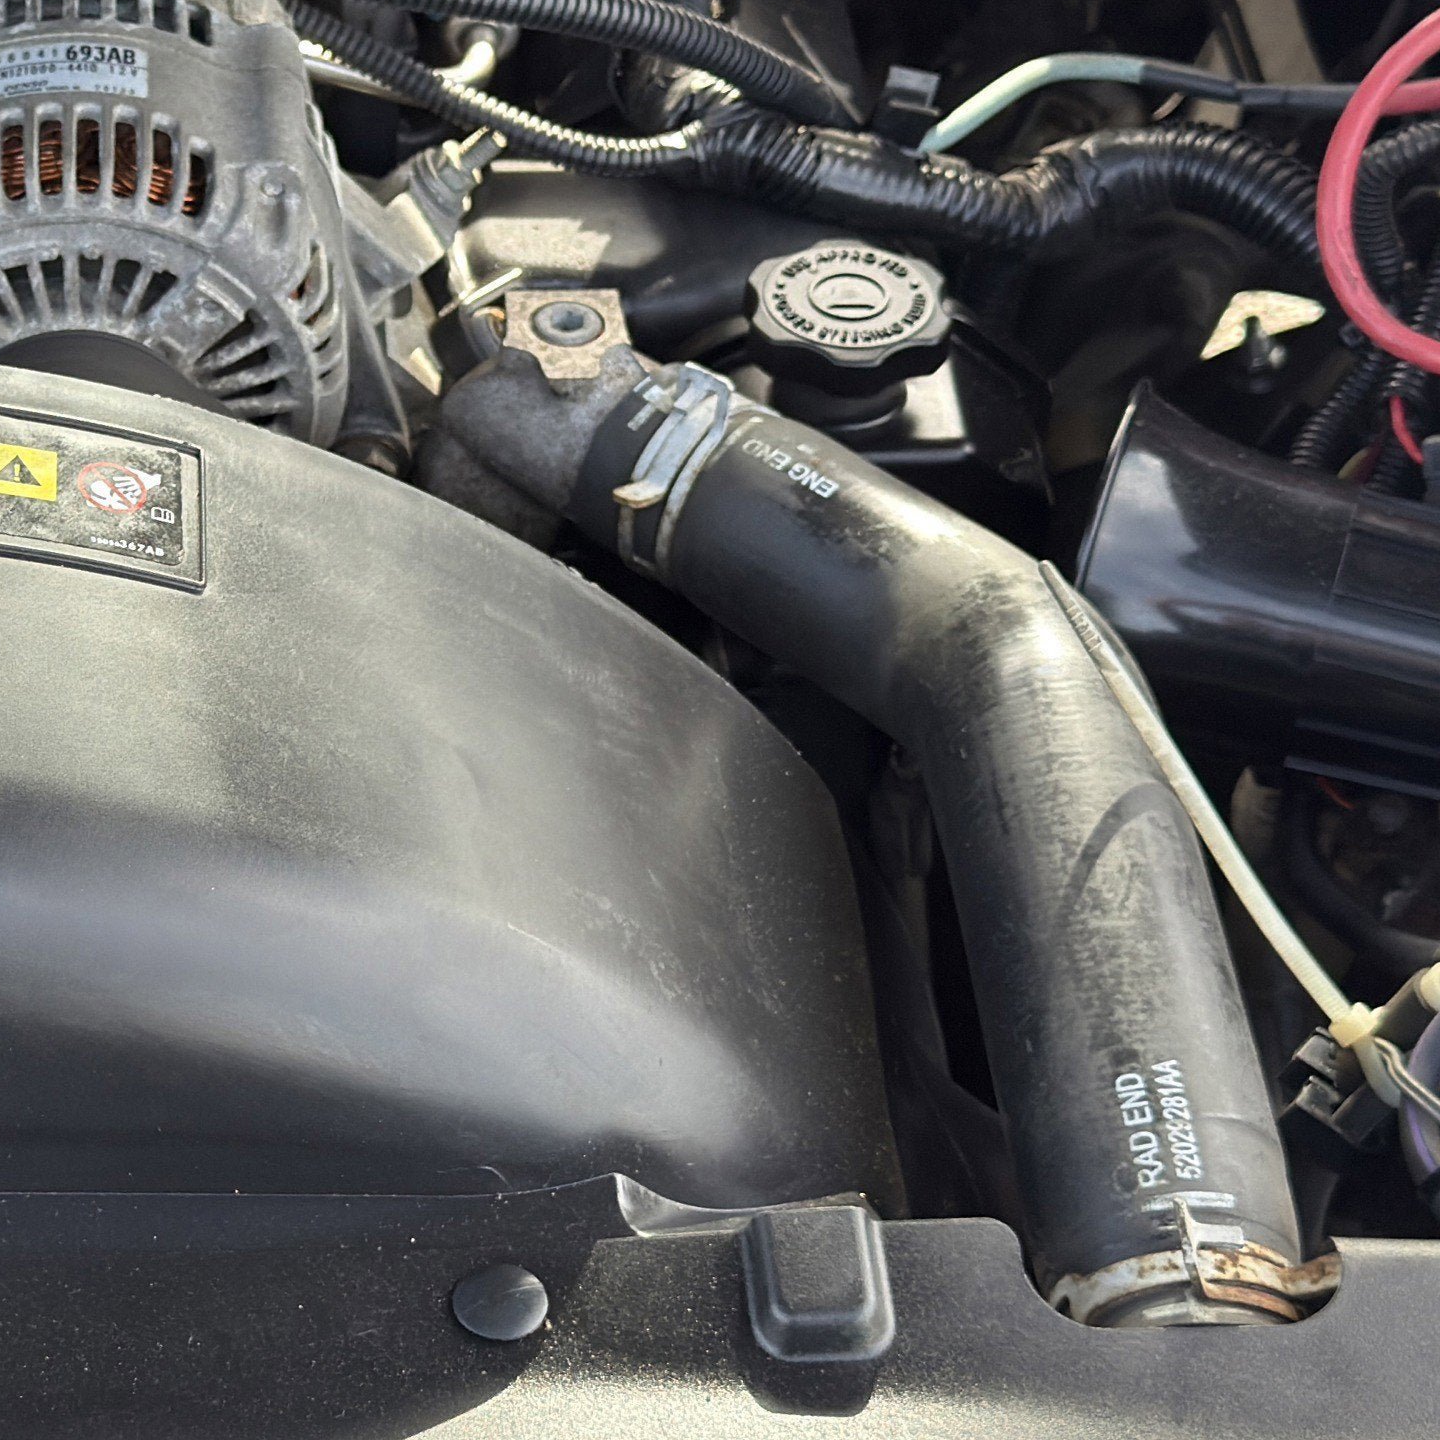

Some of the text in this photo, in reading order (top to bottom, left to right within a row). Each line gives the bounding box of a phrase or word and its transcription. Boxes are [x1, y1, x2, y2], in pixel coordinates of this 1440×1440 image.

[65, 45, 136, 66] 693AB
[742, 438, 840, 499] ENG END
[1115, 1072, 1164, 1188] RAD END
